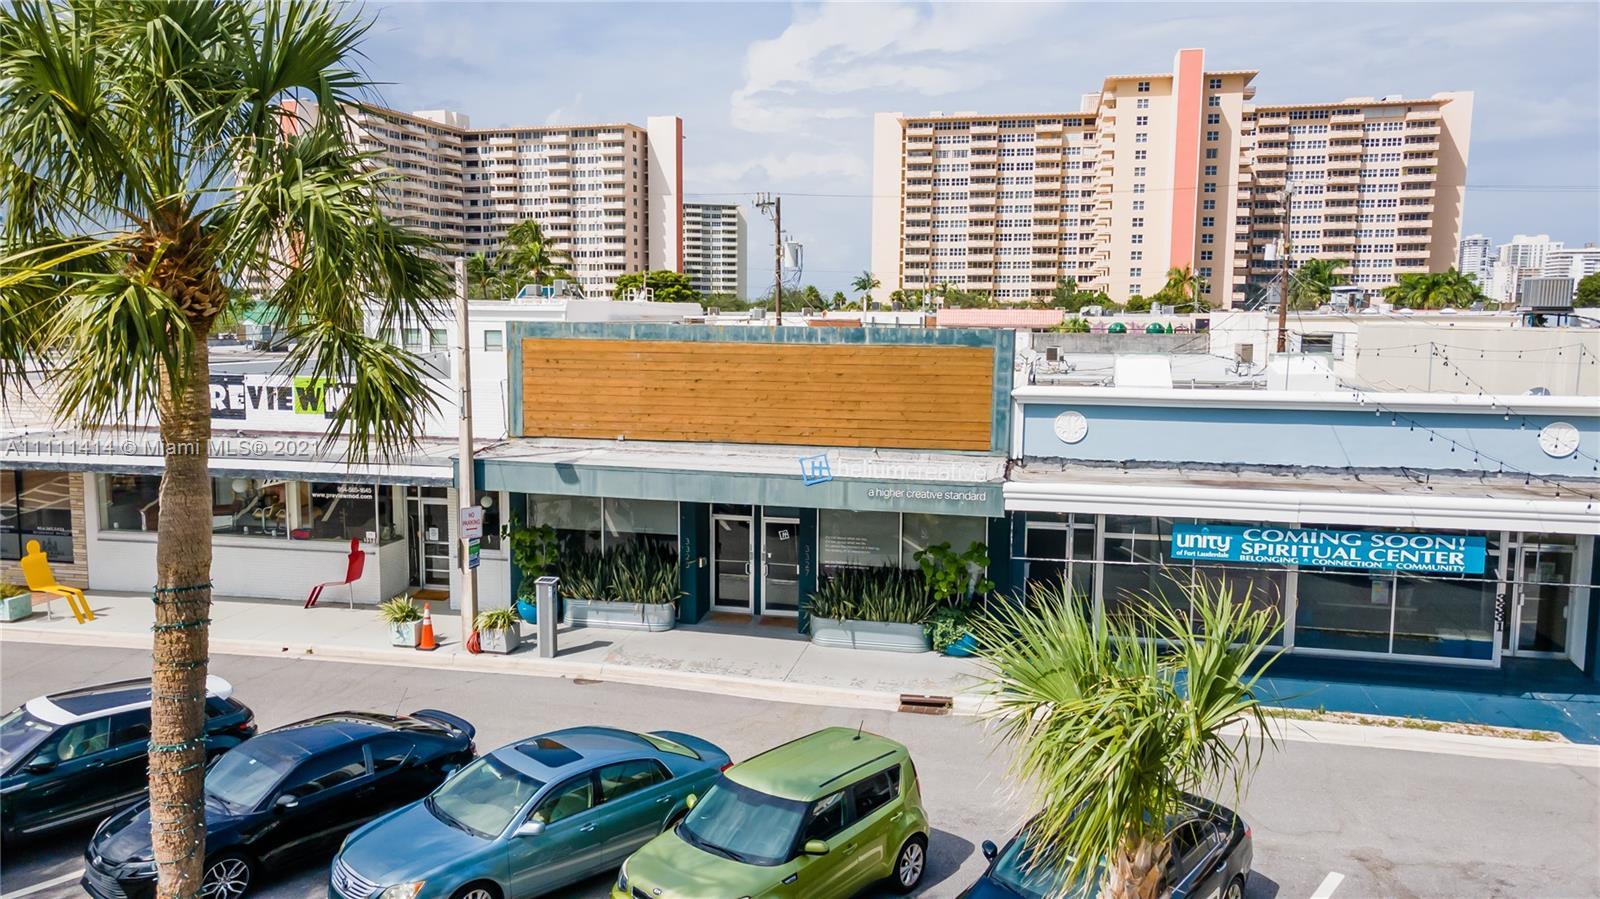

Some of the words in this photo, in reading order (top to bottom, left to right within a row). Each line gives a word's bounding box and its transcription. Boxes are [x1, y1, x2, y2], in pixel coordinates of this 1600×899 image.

[868, 489, 875, 497] a
[875, 487, 905, 499] higher
[906, 489, 943, 499] creative
[944, 491, 987, 501] standard
[1242, 528, 1362, 546] COMING
[1370, 534, 1466, 551] SOON!
[1197, 551, 1230, 559] Lauderdale
[1241, 542, 1362, 561] SPIRITUAL
[1368, 549, 1465, 565] CENTER
[1239, 555, 1299, 564] BELONGING
[1311, 559, 1383, 569] CONNECTION
[1395, 562, 1466, 572] COMMUNITY
